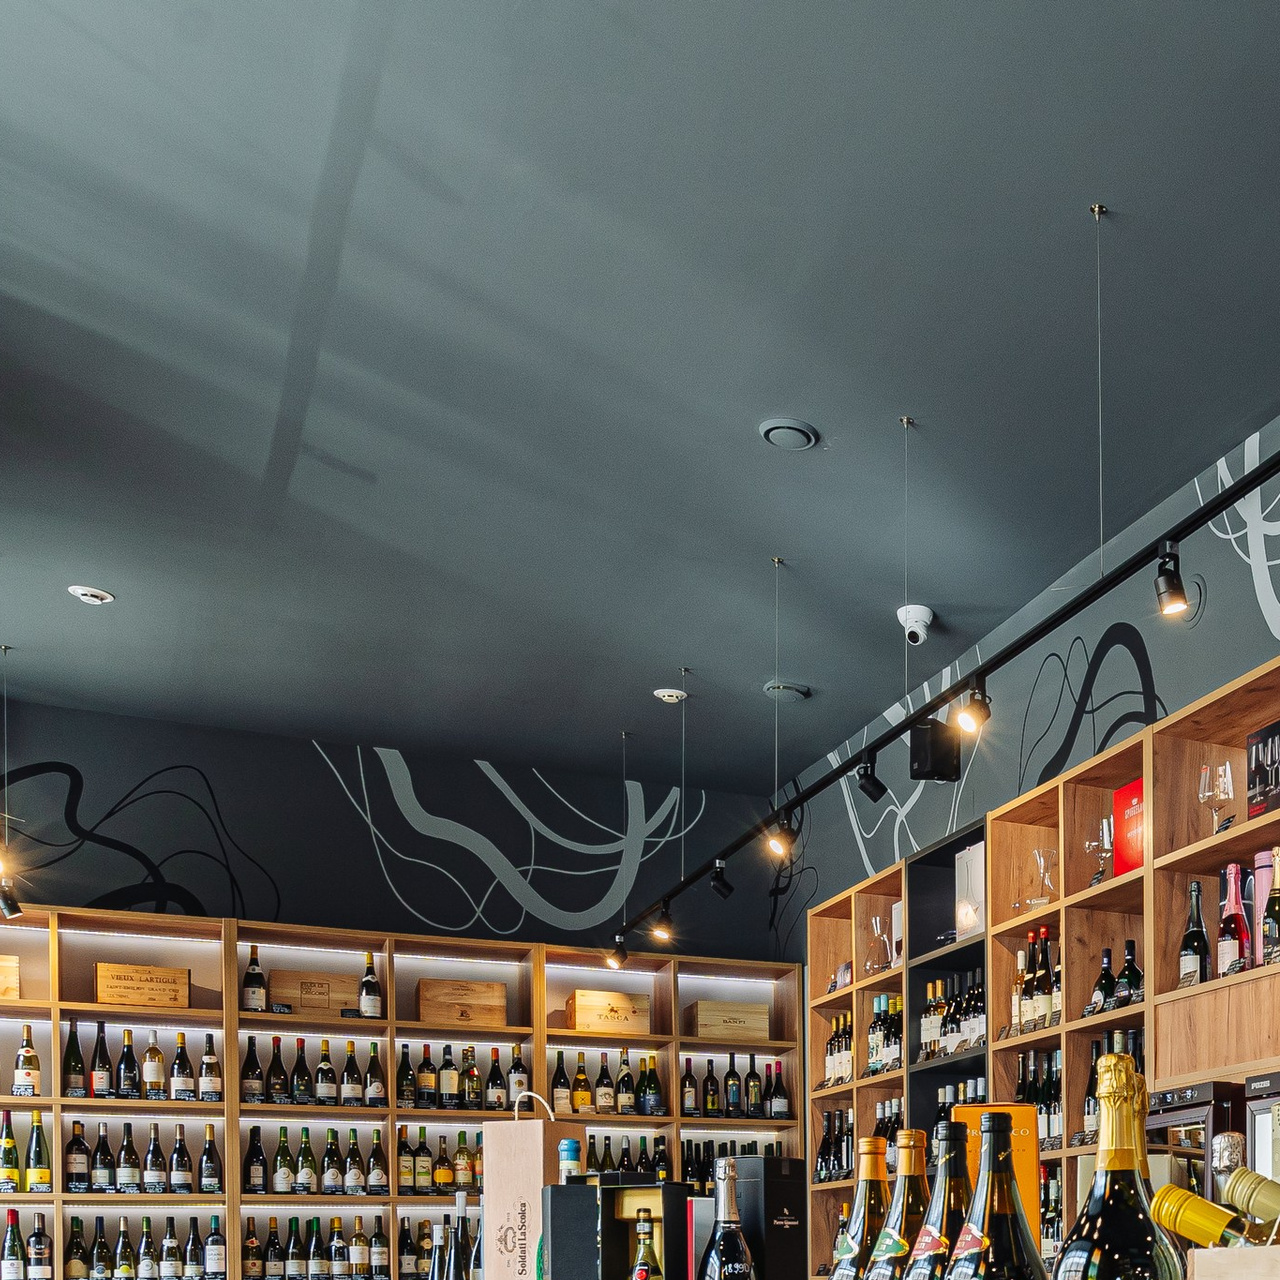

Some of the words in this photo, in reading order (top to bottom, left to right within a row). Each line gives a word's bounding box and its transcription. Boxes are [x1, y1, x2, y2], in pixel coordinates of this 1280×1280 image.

[110, 973, 134, 982] VIEUX
[139, 976, 178, 985] LARTIGUE
[597, 1014, 629, 1022] TASCA
[518, 1242, 528, 1276] Soldati
